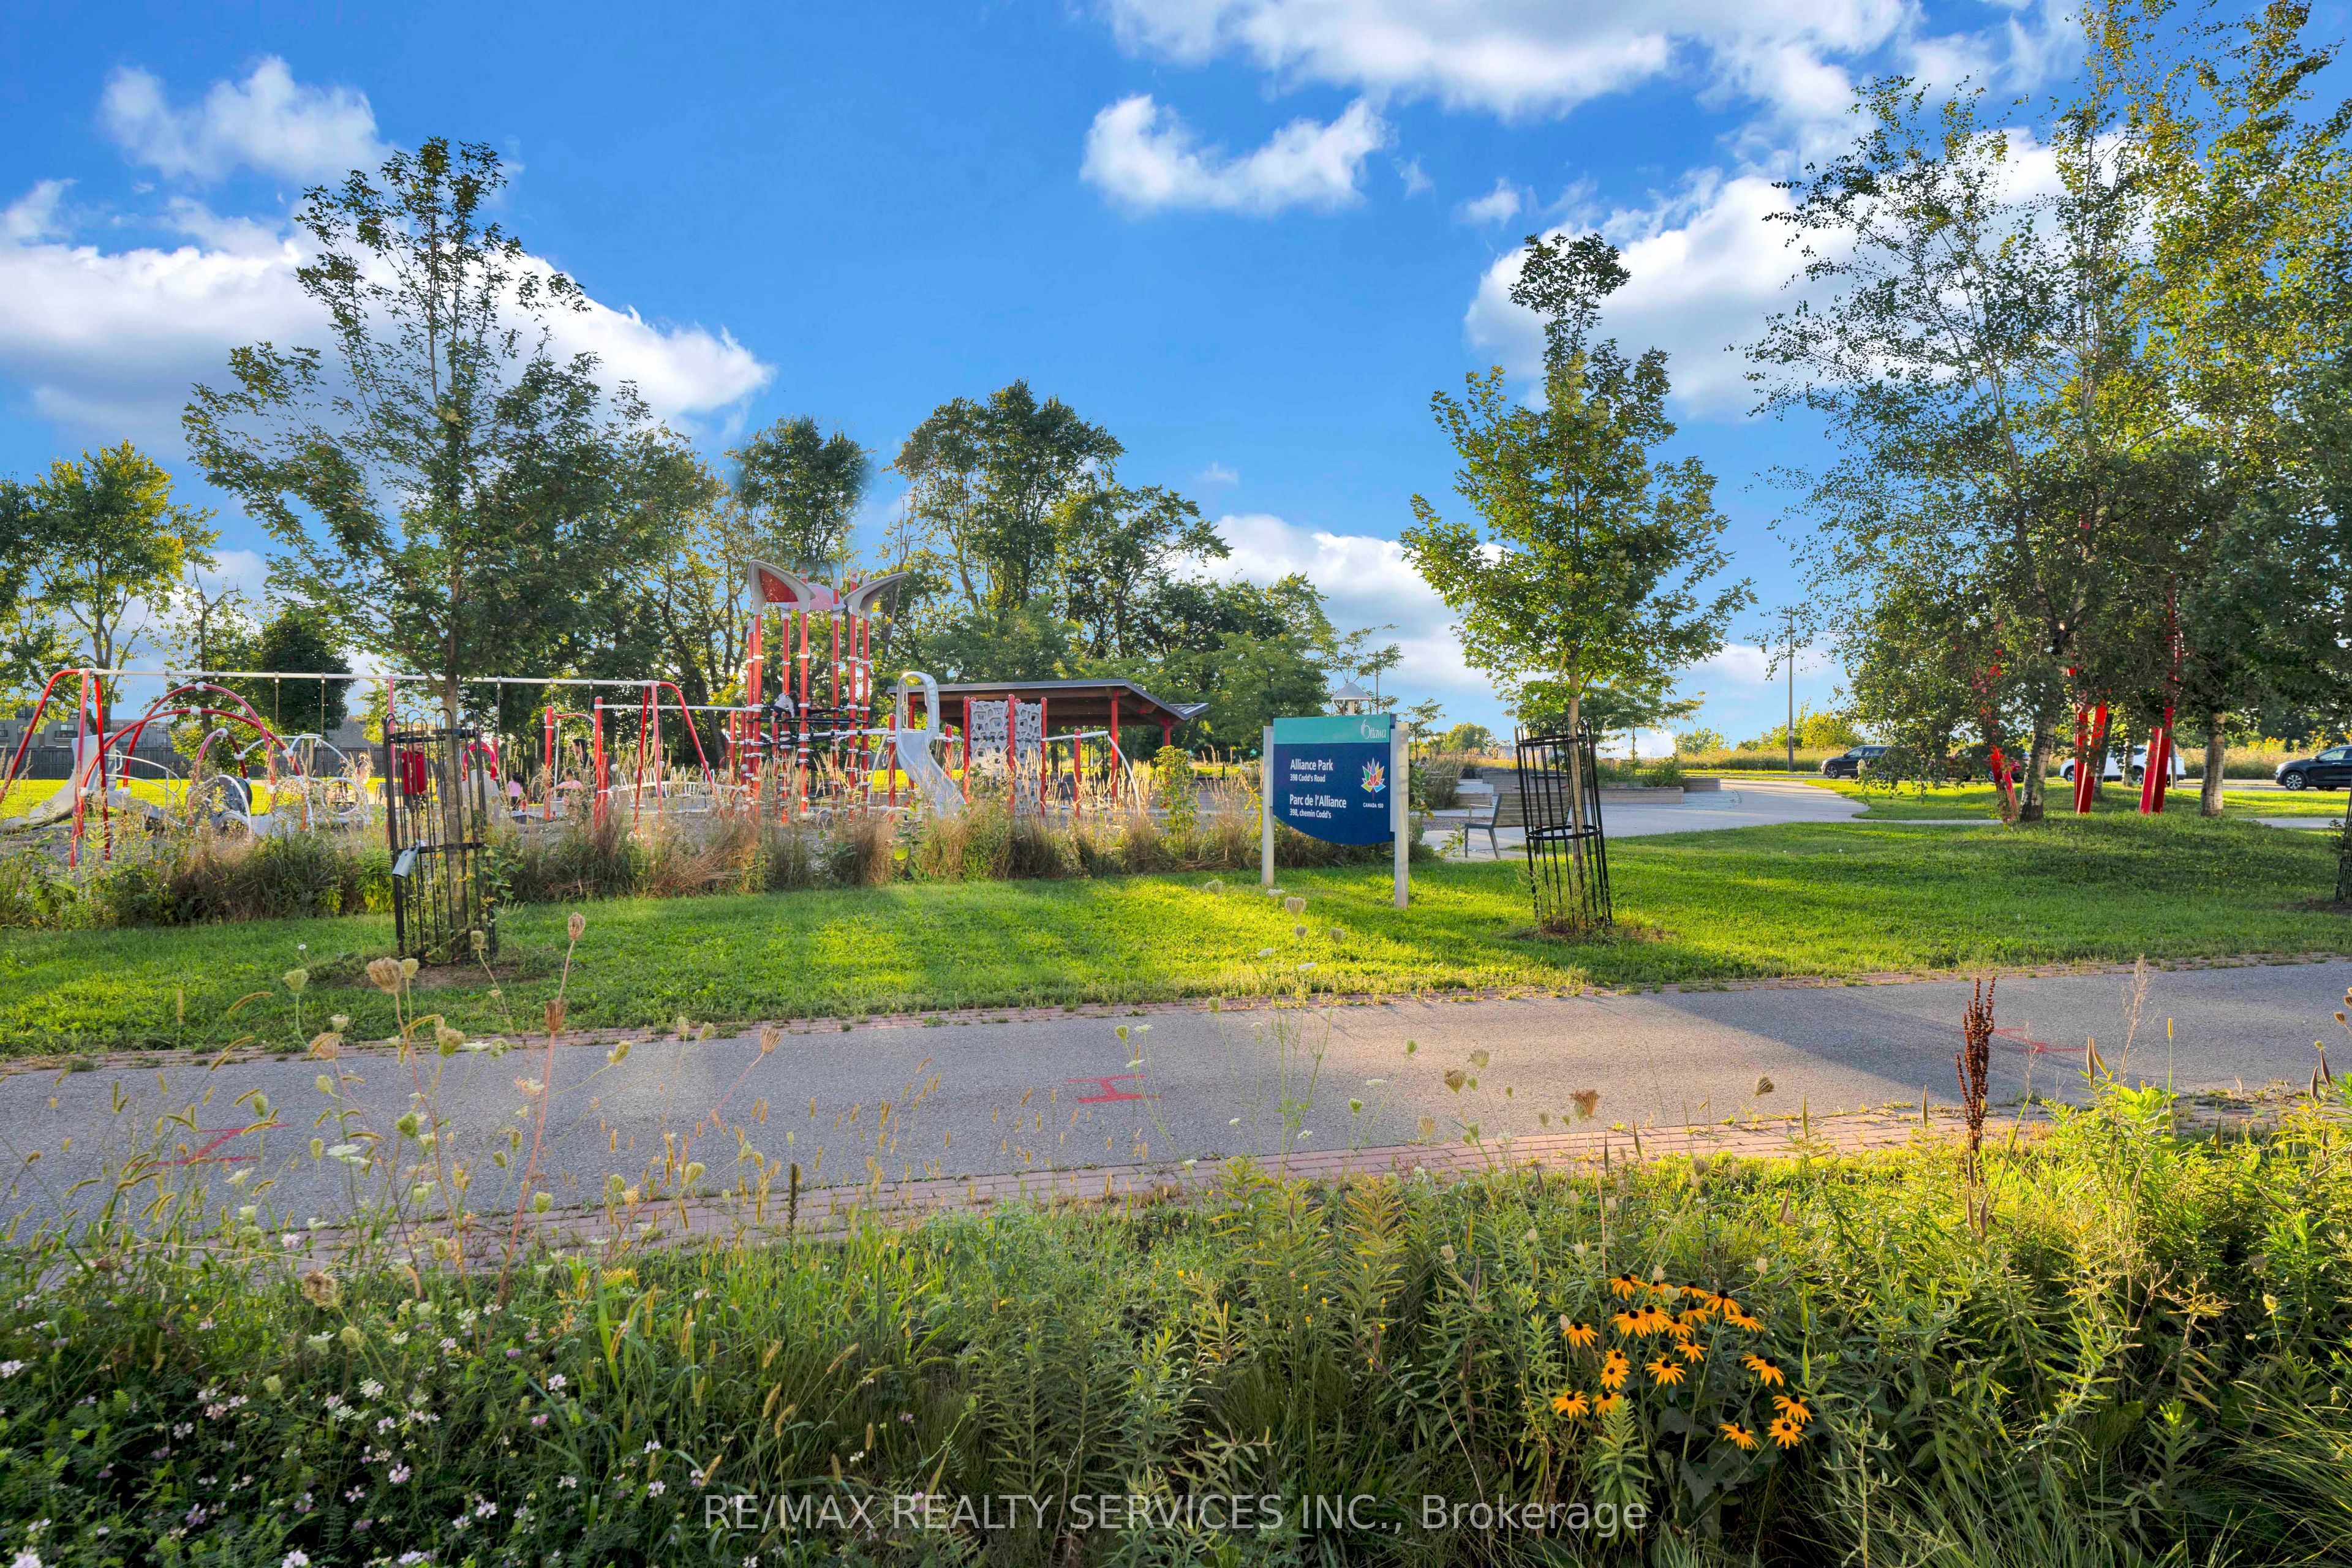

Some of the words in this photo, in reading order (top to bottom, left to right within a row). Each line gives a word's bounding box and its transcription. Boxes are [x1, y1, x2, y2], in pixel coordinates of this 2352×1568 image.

[1360, 720, 1386, 739] Ottawa
[1290, 758, 1316, 771] Alliance
[1318, 759, 1333, 771] Park
[1289, 794, 1303, 805] Parc
[1305, 794, 1313, 806] de
[1315, 794, 1347, 808] l'Alliance
[1289, 808, 1299, 817] 398,
[1299, 809, 1315, 818] chemin
[1316, 810, 1332, 818] Codd's
